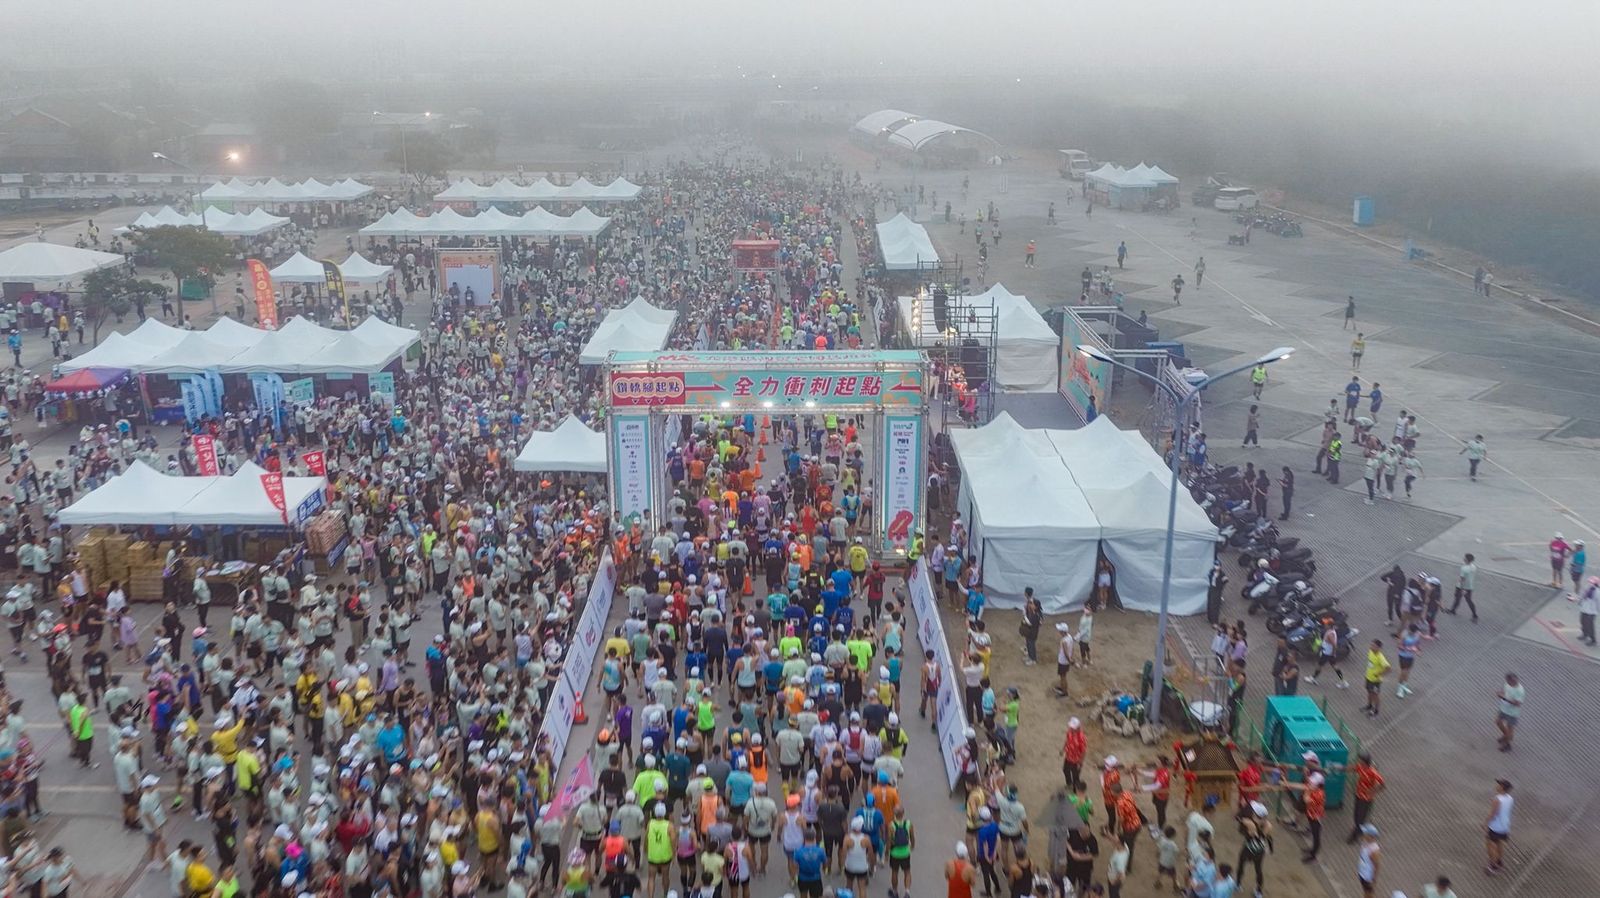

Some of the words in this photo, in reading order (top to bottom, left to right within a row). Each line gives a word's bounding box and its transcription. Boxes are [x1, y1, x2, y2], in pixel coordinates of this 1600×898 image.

[733, 376, 882, 396] 全力衝刺起點
